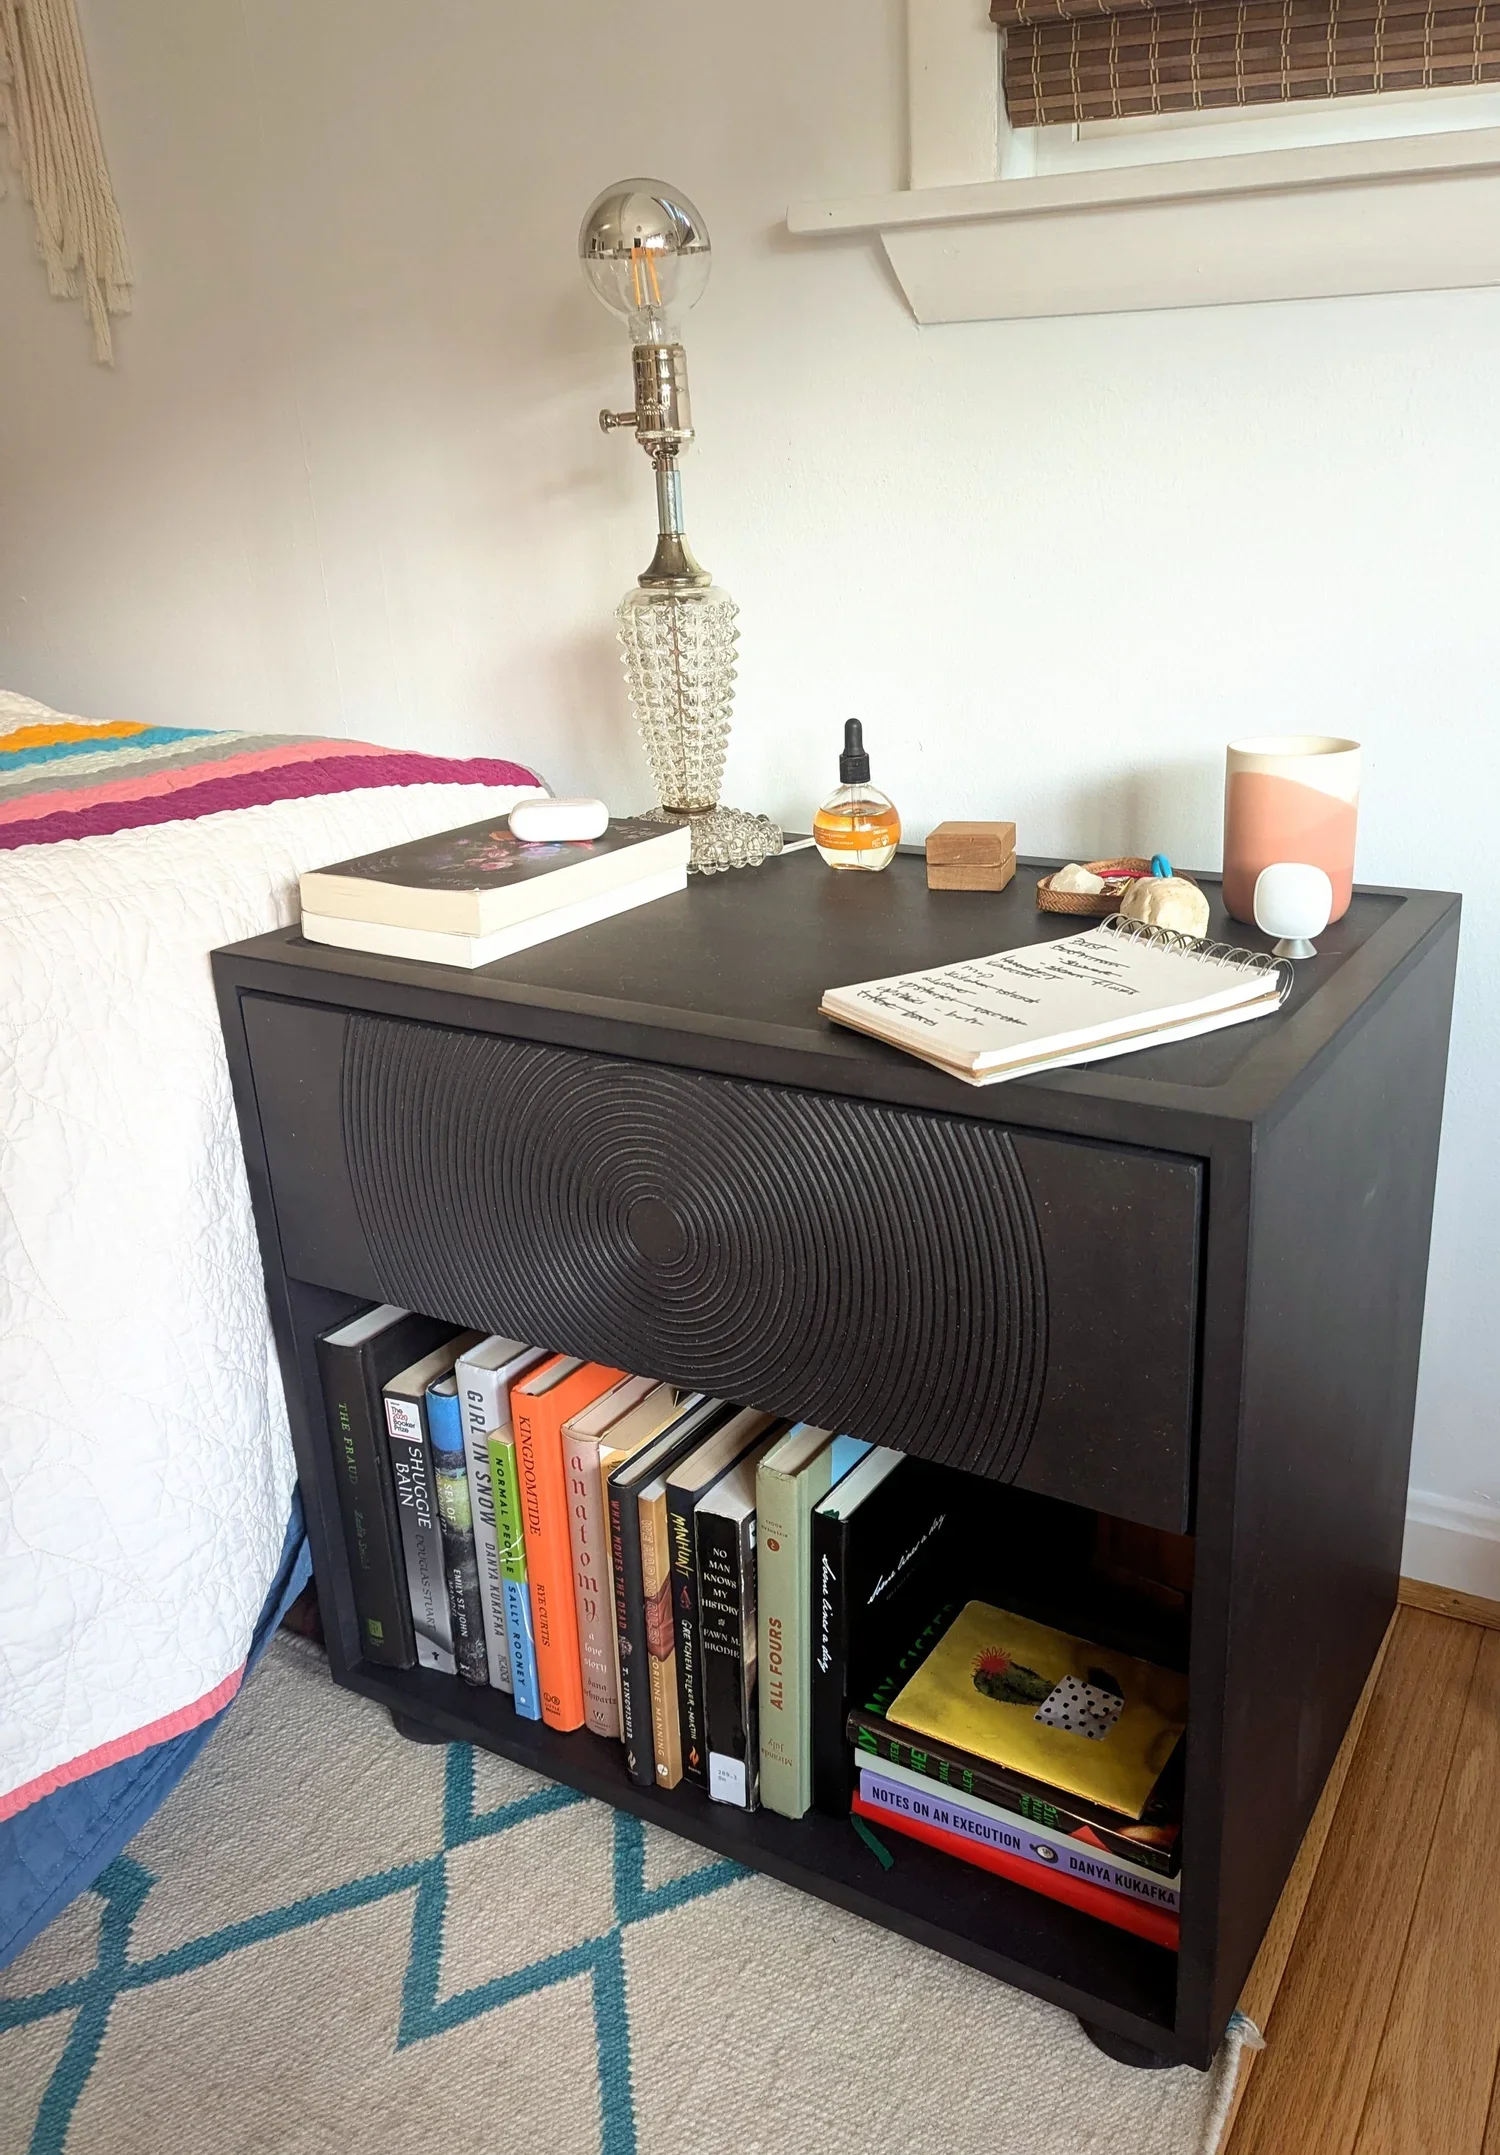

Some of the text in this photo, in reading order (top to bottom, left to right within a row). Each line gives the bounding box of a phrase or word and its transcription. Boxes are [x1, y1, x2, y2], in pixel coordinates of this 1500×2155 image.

[338, 1402, 358, 1485] THE FRAUD
[466, 1389, 496, 1528] GIRL IN SNOW
[395, 1462, 414, 1507] BAIN
[408, 1446, 432, 1529] SHUGGIE
[518, 1415, 542, 1537] KINGDOMTIDE
[444, 1484, 456, 1522] SEA OF
[495, 1457, 514, 1574] NORMAL PEOPLE
[571, 1455, 599, 1622] anatomy
[641, 1520, 653, 1542] WE
[670, 1512, 694, 1580] MANHUNT
[712, 1548, 728, 1559] NO
[415, 1534, 437, 1632] DOUGLAS STUART
[610, 1500, 627, 1630] WHAT MOVES THE DEAD
[644, 1544, 656, 1576] HAD
[703, 1572, 738, 1590] KNOWS
[708, 1560, 731, 1574] MAN
[453, 1568, 468, 1638] EMILY ST. JOHN
[485, 1542, 504, 1637] DANYA KUKAFKA
[508, 1586, 520, 1626] SALLY
[701, 1598, 740, 1616] HISTORY
[712, 1588, 728, 1599] MY
[536, 1583, 550, 1648] RYE CURTIS
[588, 1632, 595, 1640] a
[646, 1600, 660, 1646] RULES
[704, 1628, 741, 1646] FAWN M.
[512, 1632, 526, 1686] ROONEY
[584, 1642, 602, 1657] love
[584, 1658, 607, 1674] story
[681, 1618, 693, 1672] GRETCHEN
[704, 1641, 740, 1659] BRODIE
[768, 1617, 783, 1711] ALL FOURS
[588, 1677, 607, 1692] dana
[623, 1680, 633, 1739] KINGFISHER
[652, 1655, 665, 1757] CORINNE MANNING
[768, 1738, 784, 1752] July
[872, 1786, 1021, 1850] NOTES ON AN EXECUTION
[1070, 1856, 1111, 1882] DANYA
[1115, 1874, 1176, 1906] KUKAFKA
